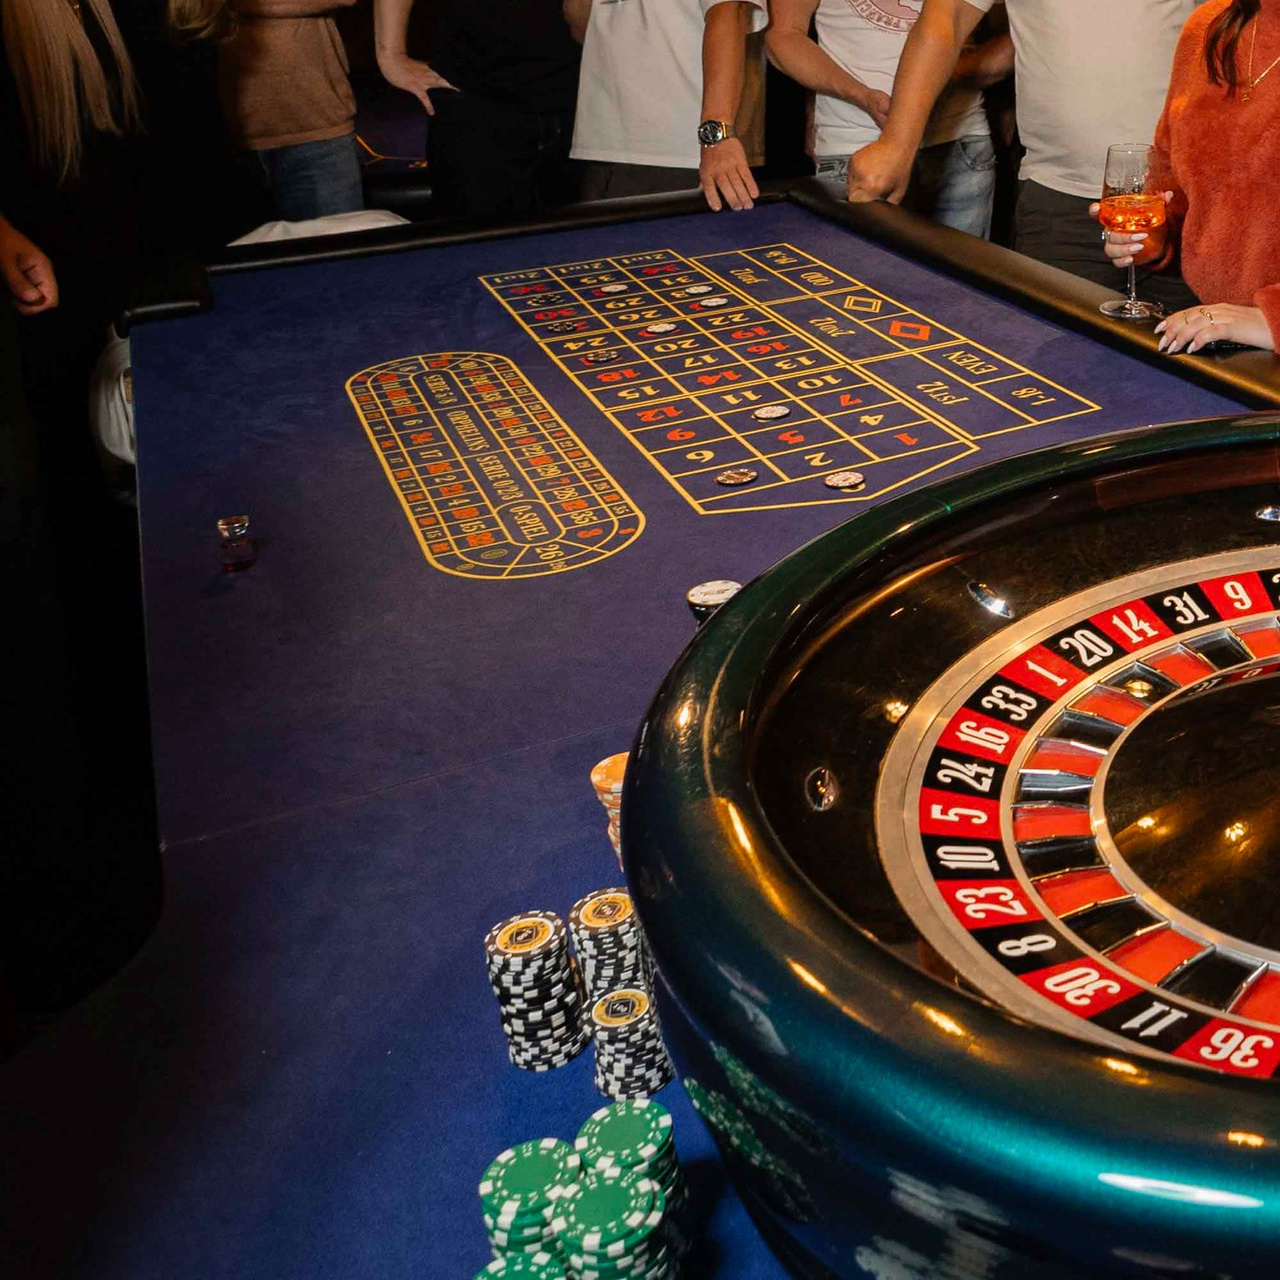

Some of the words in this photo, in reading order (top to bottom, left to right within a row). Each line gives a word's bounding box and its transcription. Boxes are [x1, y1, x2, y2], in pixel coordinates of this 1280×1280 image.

[579, 273, 616, 285] 35
[660, 275, 694, 286] 31
[800, 271, 835, 286] ODD
[605, 297, 646, 310] 29
[533, 307, 578, 320] 30
[618, 309, 662, 322] 26
[708, 312, 750, 326] 22
[731, 326, 771, 340] 19
[563, 336, 609, 351] 24
[653, 338, 700, 353] 20
[746, 341, 790, 355] 16
[683, 353, 720, 368] 17
[774, 355, 816, 370] 13
[942, 350, 999, 376] EVEN
[597, 368, 641, 383] 18
[696, 369, 742, 386] 14
[796, 374, 843, 390] 10
[617, 385, 661, 400] 15
[720, 389, 763, 405] 11
[839, 393, 863, 408] 7
[1010, 386, 1057, 406] 1-18
[636, 405, 684, 423] 12
[859, 413, 885, 427] 4
[403, 419, 423, 427] 6
[447, 411, 490, 451] ORPHELINS
[507, 425, 530, 437] 31
[666, 428, 697, 441] 9
[777, 429, 805, 445] 5
[894, 432, 919, 446] 1
[419, 449, 443, 458] 17
[521, 444, 546, 457] 22
[685, 449, 715, 463] 6
[477, 454, 509, 480] SERIE
[803, 451, 834, 468] 2
[535, 463, 563, 478] 29
[434, 474, 456, 484] 2
[548, 477, 570, 485] 7
[552, 485, 578, 501] 28
[448, 498, 469, 507] 4
[510, 504, 548, 541] 0-SPIEL
[569, 509, 599, 526] 35
[460, 518, 487, 534] 15
[535, 543, 564, 560] 26
[1226, 582, 1252, 609] 9
[1164, 592, 1209, 624] 31
[1113, 610, 1158, 643] 14
[1060, 630, 1113, 666] 20
[1027, 661, 1067, 686] 1
[982, 686, 1037, 720] 33
[956, 722, 1009, 753] 16
[937, 759, 994, 791] 24
[932, 805, 987, 823] 5
[937, 846, 999, 871] 10
[956, 882, 1032, 918] 23
[999, 935, 1056, 956] 8
[1045, 962, 1125, 1004] 30
[1122, 1002, 1187, 1036] 11
[1201, 1029, 1273, 1067] 36
